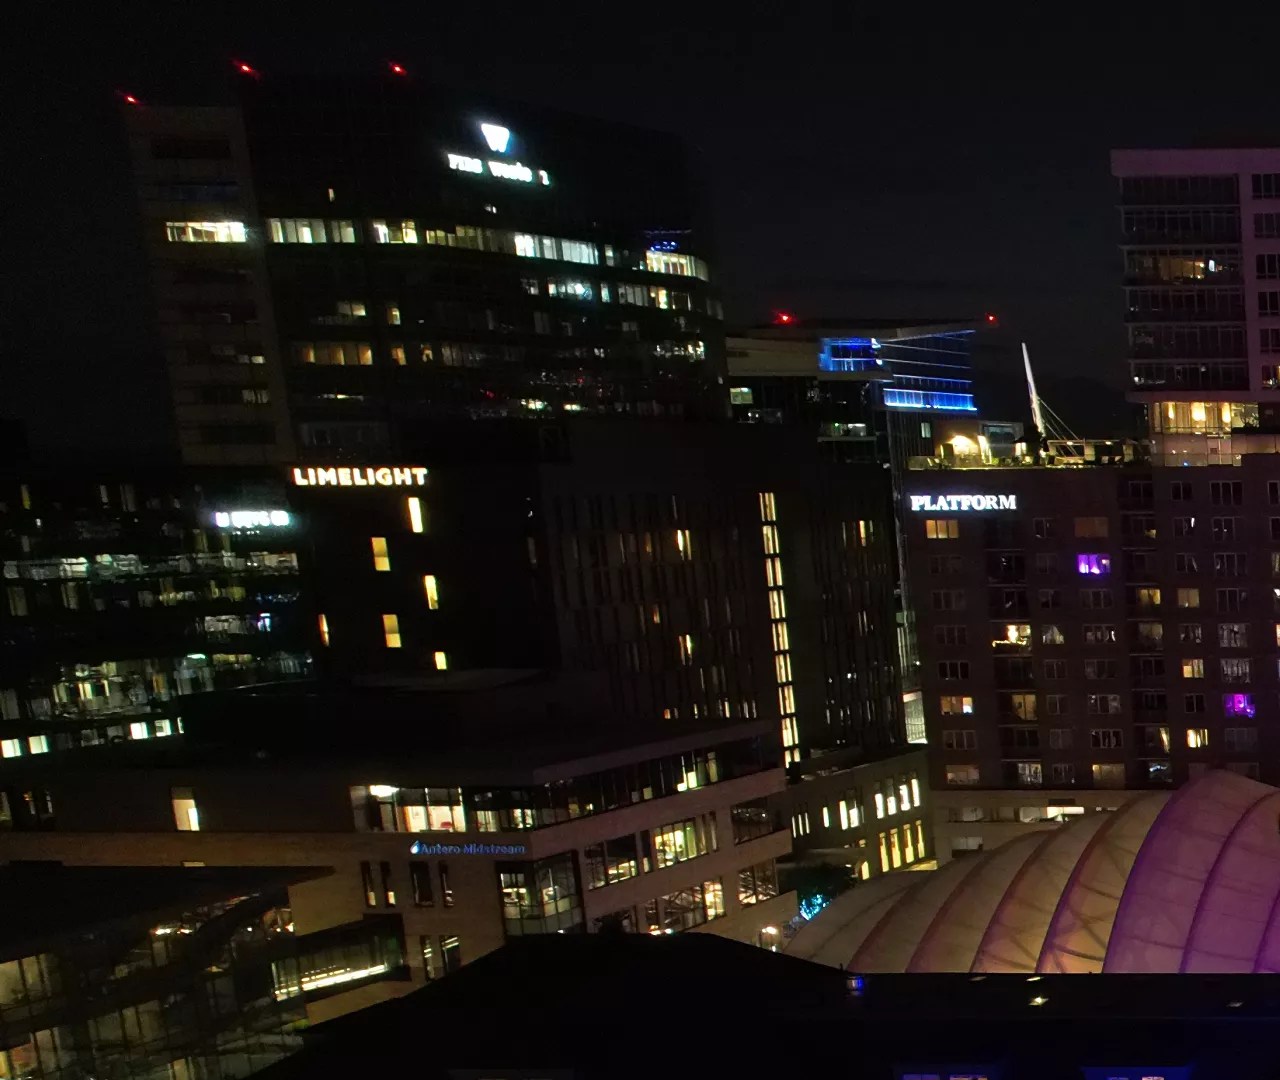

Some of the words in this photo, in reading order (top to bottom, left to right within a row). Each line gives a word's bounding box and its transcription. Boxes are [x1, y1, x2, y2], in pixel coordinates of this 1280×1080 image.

[293, 467, 428, 485] LIMELIGHT
[910, 494, 1017, 511] PLATFORM
[421, 843, 460, 854] Antero
[463, 843, 525, 854] Midstream
